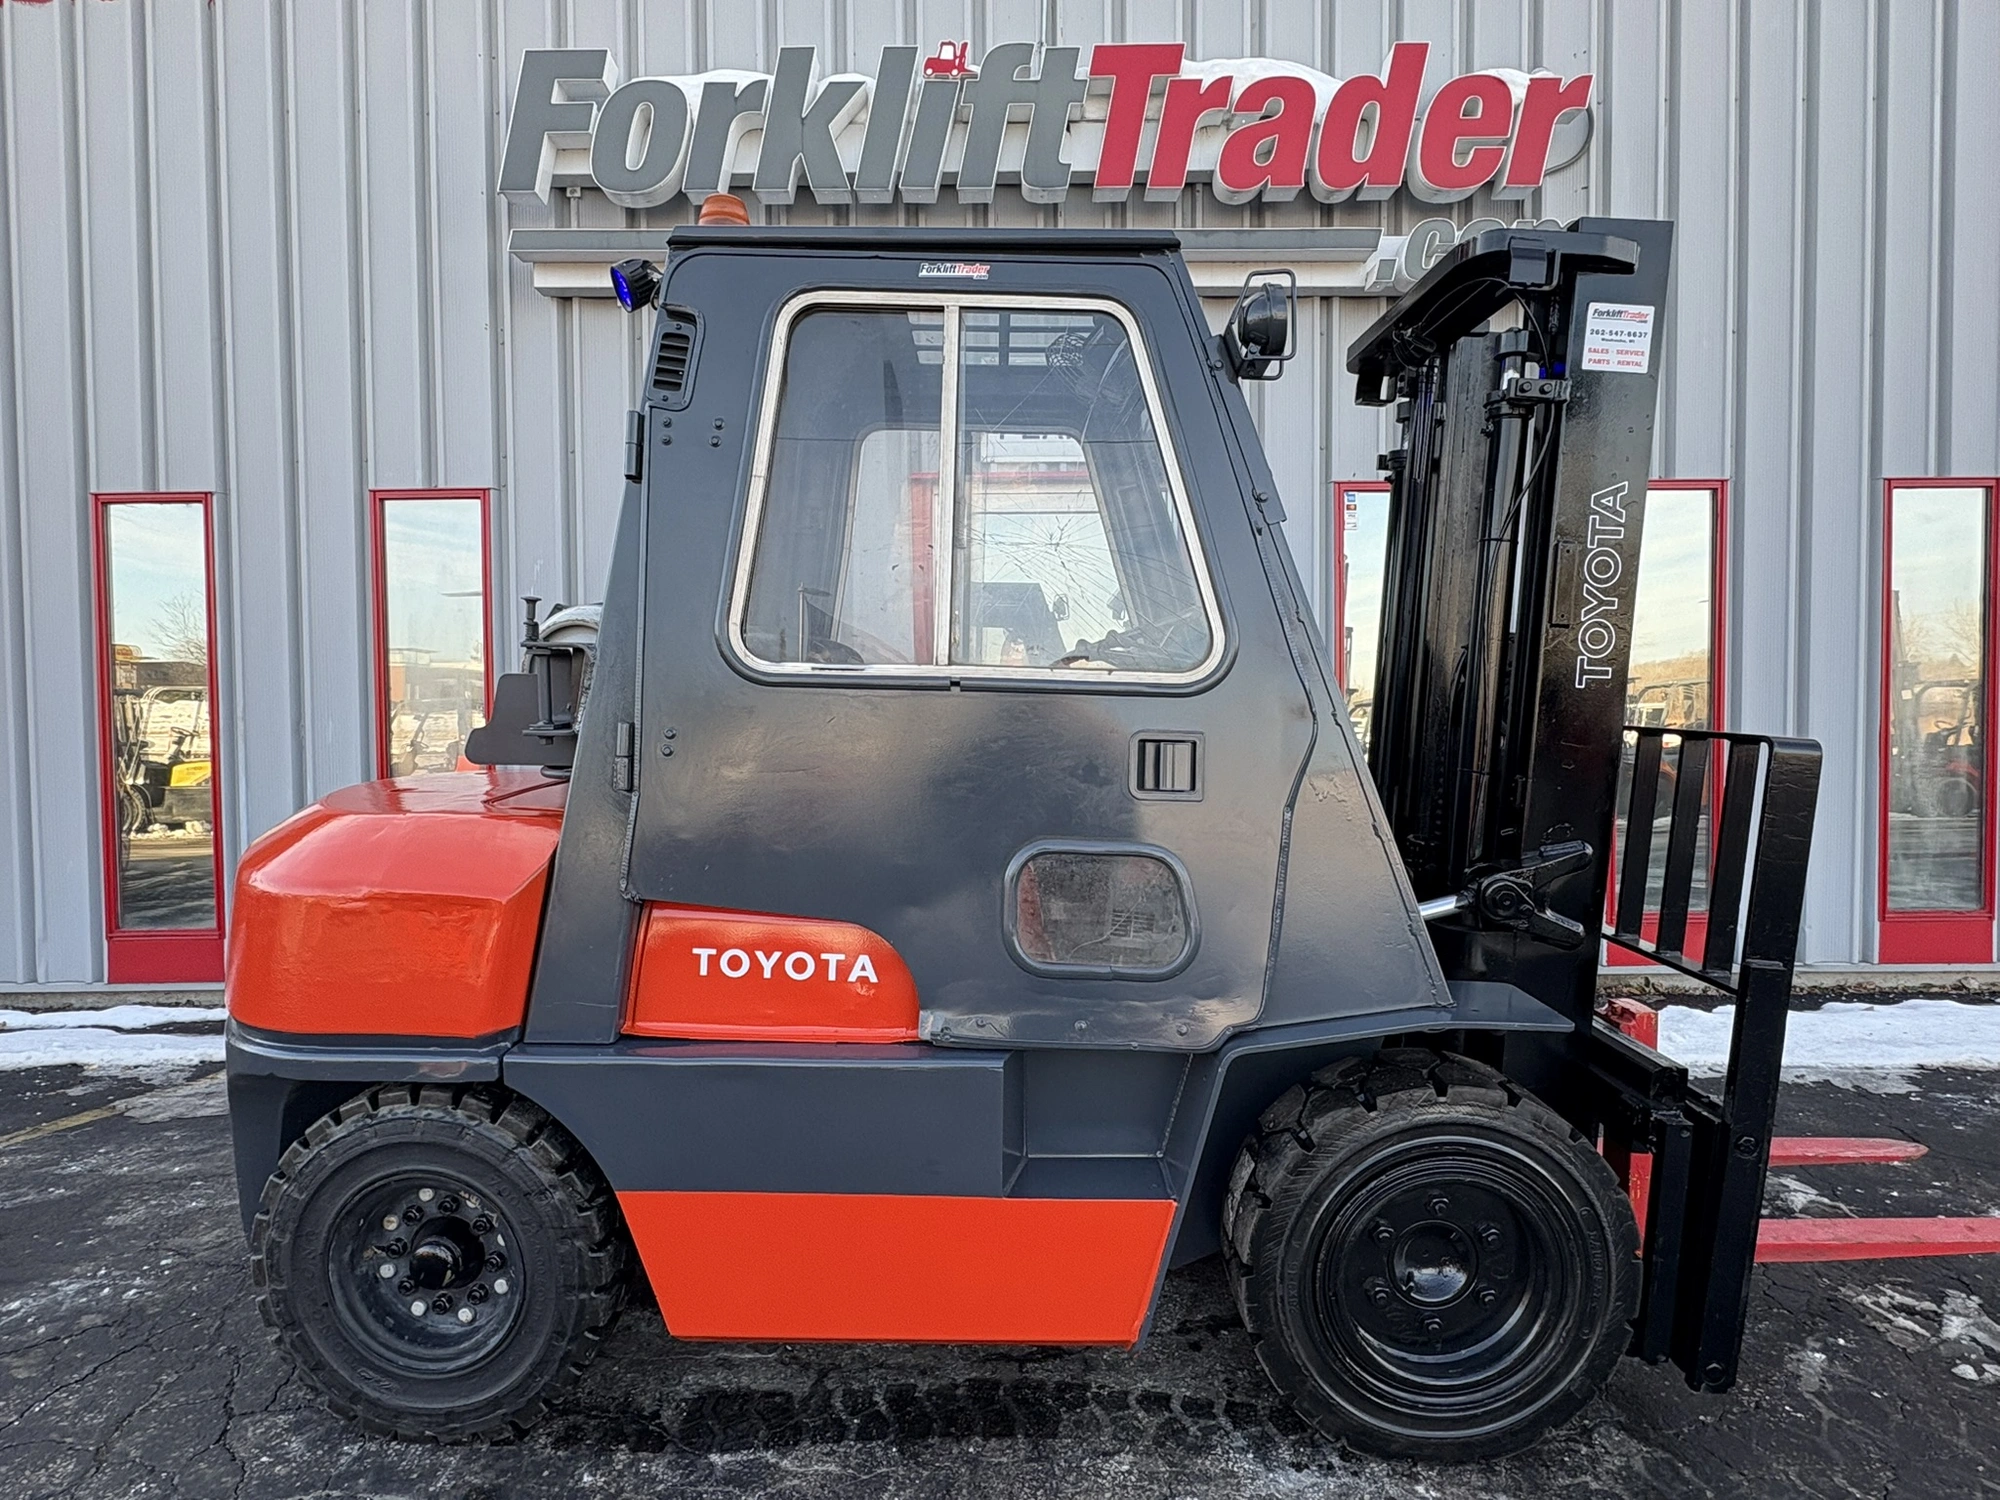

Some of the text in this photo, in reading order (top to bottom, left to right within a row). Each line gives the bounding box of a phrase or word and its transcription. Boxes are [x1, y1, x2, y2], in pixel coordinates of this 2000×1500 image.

[497, 40, 1594, 196] ForkliftTrader
[920, 263, 989, 274] ForkliftTrader
[1592, 308, 1650, 319] ForkliftTrader
[1616, 349, 1646, 357] SERVICE
[1575, 480, 1629, 689] TOYOTA
[691, 947, 879, 984] TOYOTA
